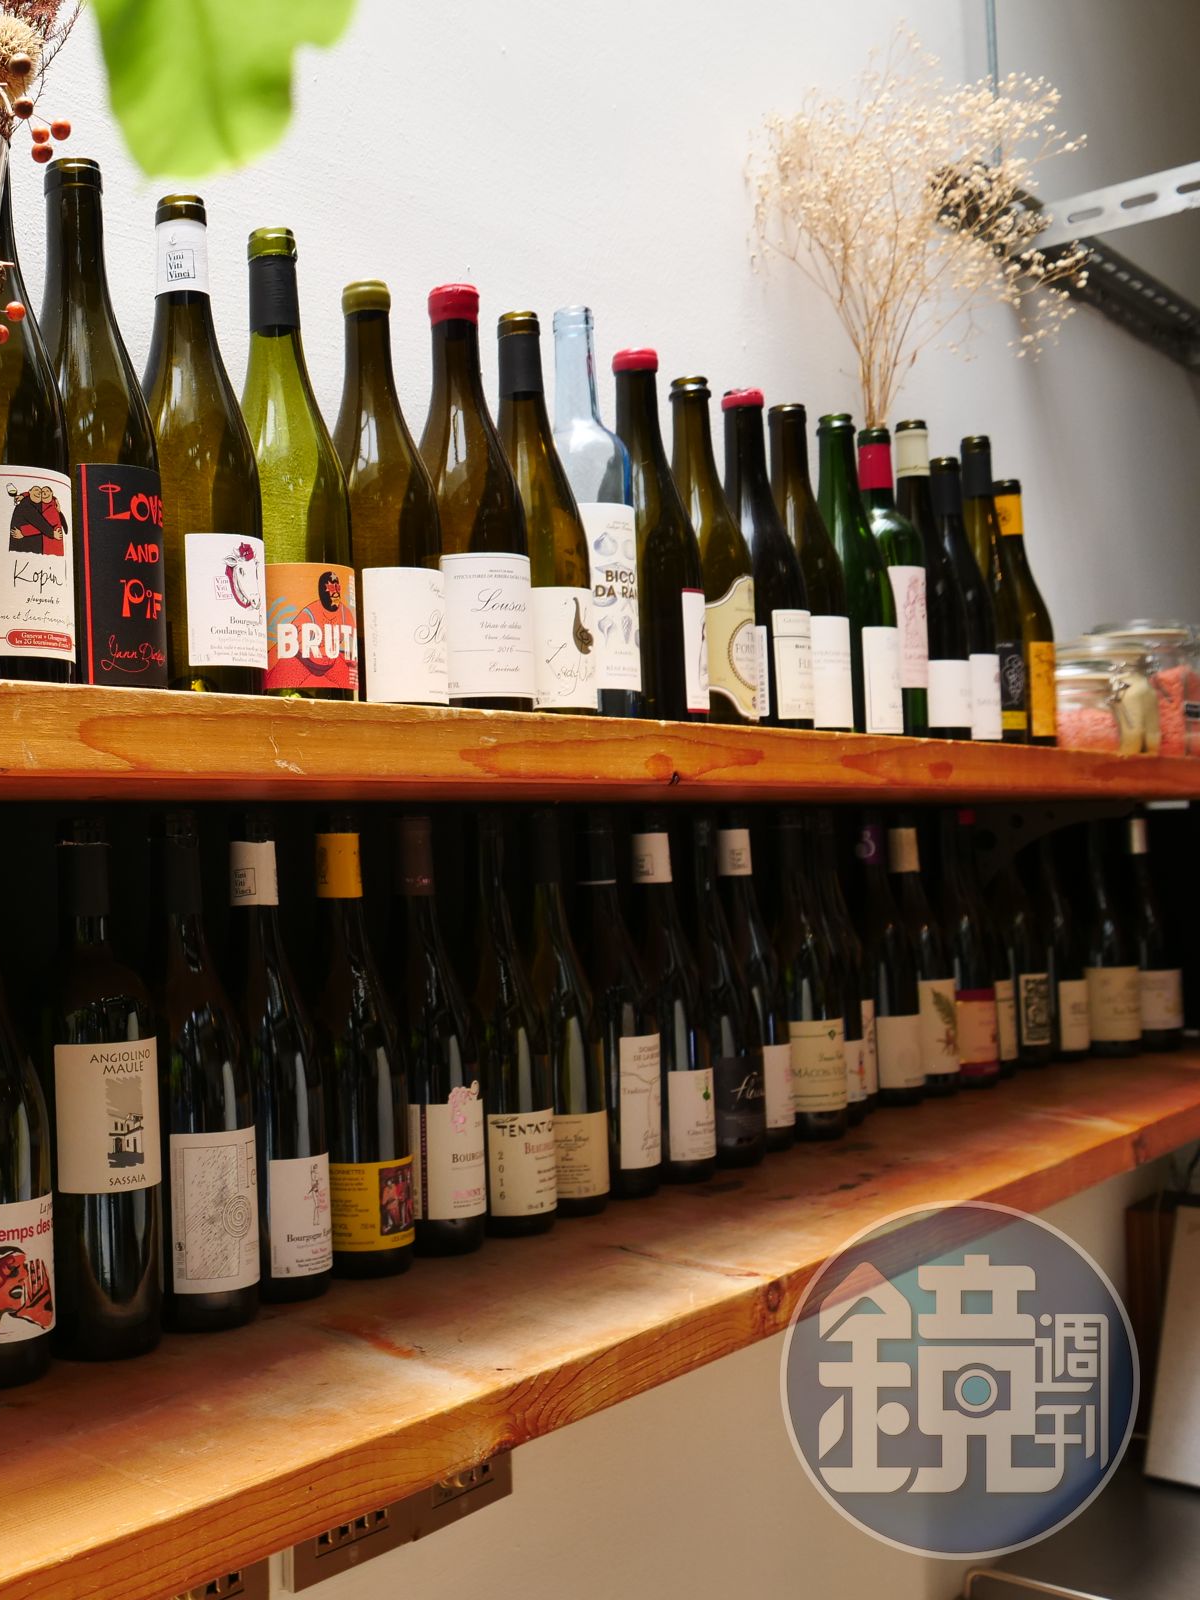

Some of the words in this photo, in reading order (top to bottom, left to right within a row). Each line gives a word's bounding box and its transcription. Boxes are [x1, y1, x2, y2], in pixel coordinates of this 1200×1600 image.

[168, 252, 184, 261] Vini
[168, 261, 182, 270] Viti
[169, 269, 190, 279] Vinci
[125, 541, 160, 564] AND
[605, 570, 636, 584] BICO
[595, 584, 617, 598] DA
[470, 588, 527, 613] Lousas
[89, 1048, 151, 1064] ANGIOLINO
[102, 1061, 144, 1075] MAULE
[109, 1174, 146, 1186] SASSAIA
[37, 1218, 51, 1236] des
